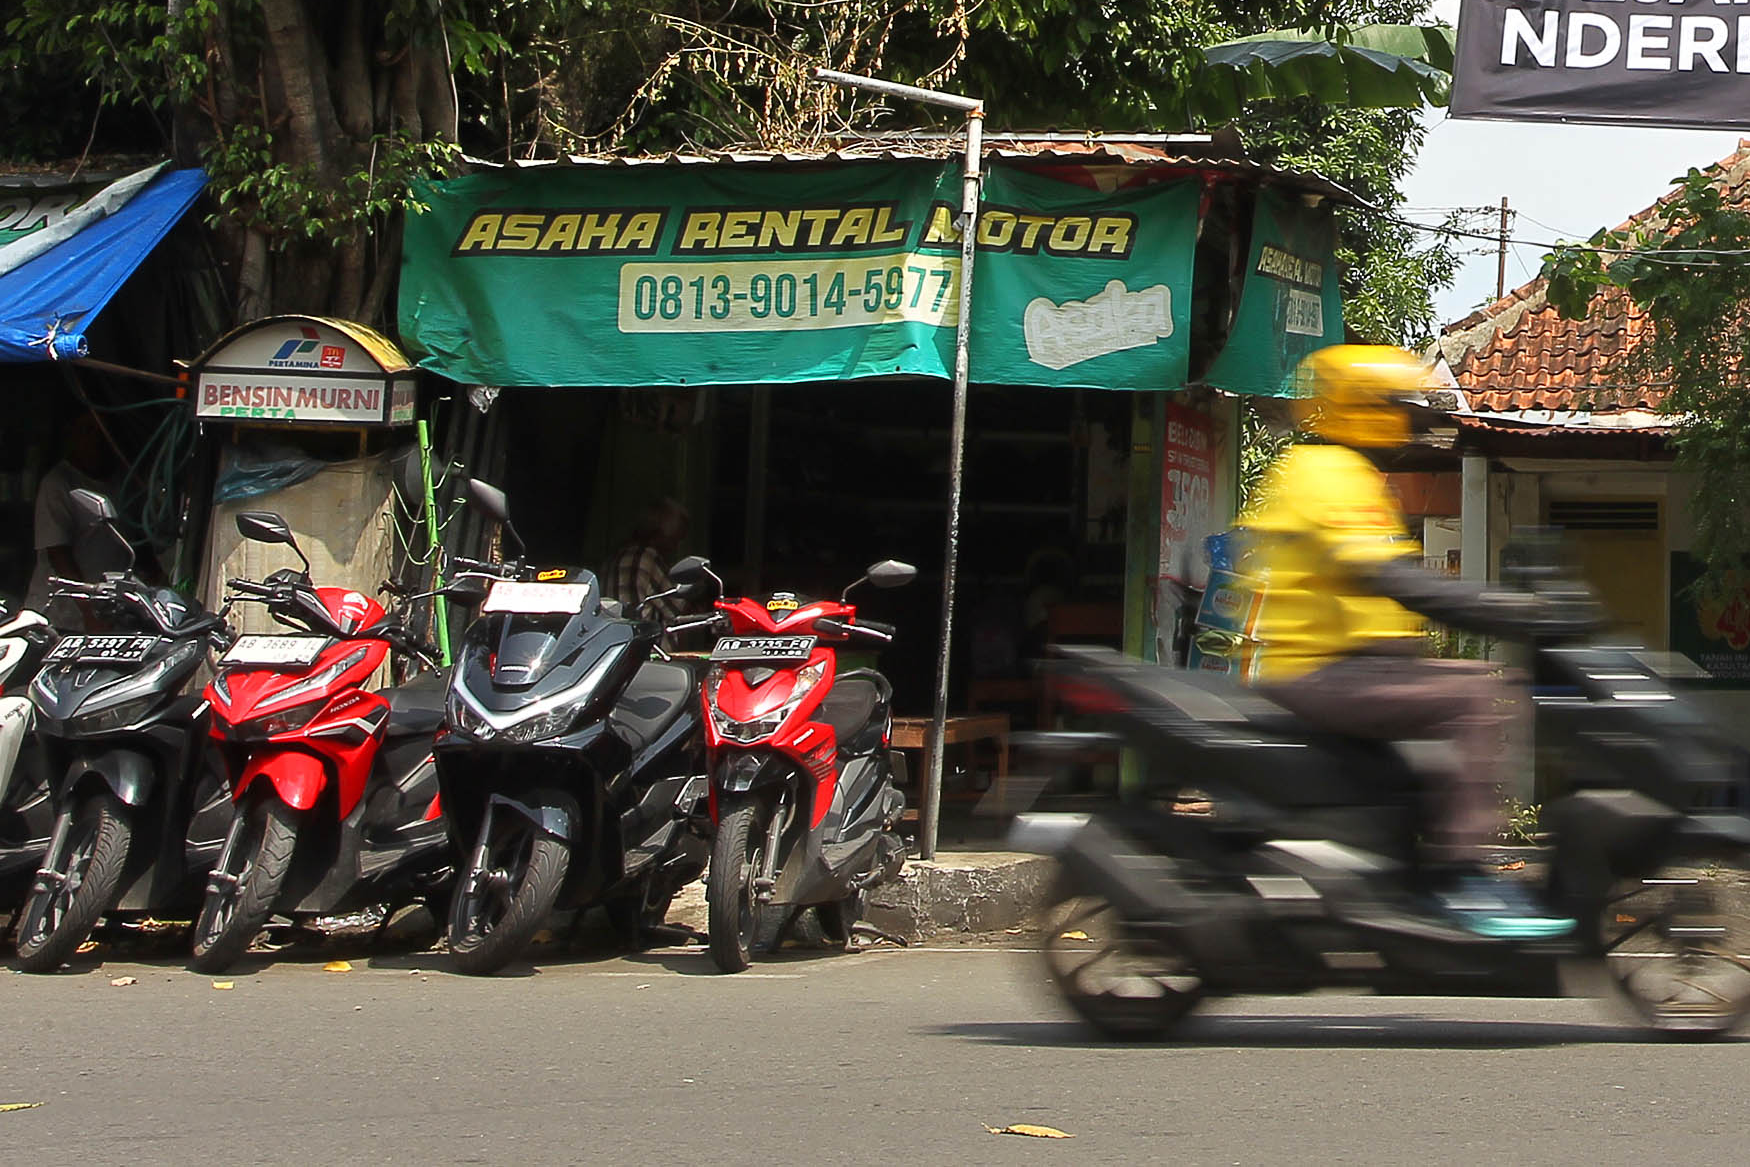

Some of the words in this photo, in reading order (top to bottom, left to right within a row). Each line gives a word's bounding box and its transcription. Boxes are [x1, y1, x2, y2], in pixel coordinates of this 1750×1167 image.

[459, 212, 661, 251] ASAKA
[679, 207, 905, 249] RENTAL
[924, 206, 1134, 254] MOTOR
[634, 265, 952, 319] 0813-9014-5977
[268, 360, 319, 369] PERTAMINA
[204, 385, 294, 408] BENSIN
[296, 387, 380, 410] MURNI
[220, 407, 296, 418] PERTA
[61, 639, 83, 648] AB
[88, 639, 127, 648] 5297
[130, 639, 151, 648] FR
[239, 639, 257, 649] AB
[722, 641, 740, 650] AB
